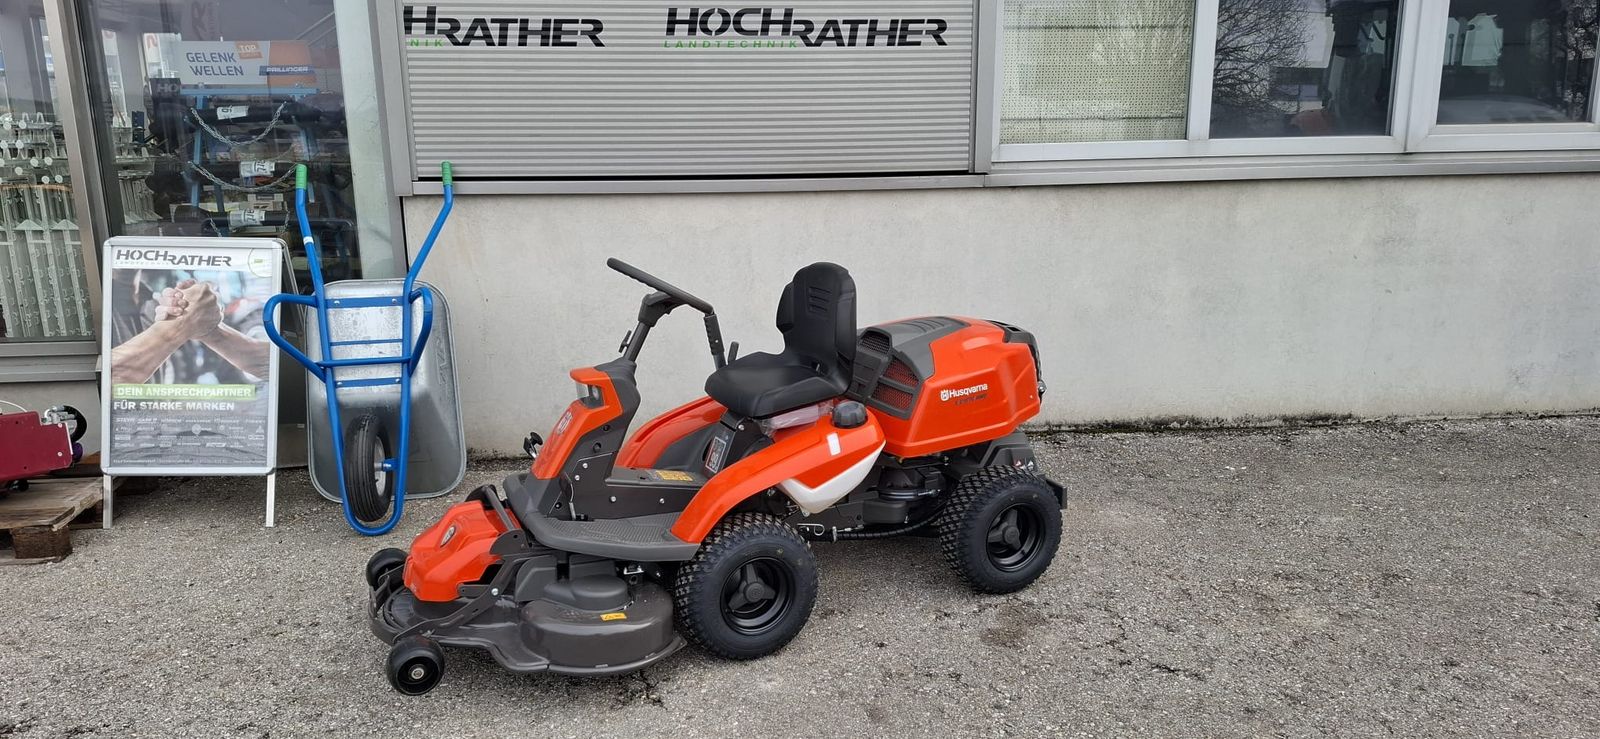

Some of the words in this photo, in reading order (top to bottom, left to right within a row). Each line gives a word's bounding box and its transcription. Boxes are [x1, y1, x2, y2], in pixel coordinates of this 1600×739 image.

[665, 7, 948, 47] HOCHRATHER
[239, 44, 257, 53] TOP
[663, 39, 797, 48] LANDTECHNIK
[186, 52, 236, 63] GELENK
[190, 65, 244, 76] WELLEN
[116, 249, 232, 267] HOCHRATHER
[117, 387, 143, 396] DEIN
[146, 387, 251, 397] ANSPRECHPARTNER
[949, 384, 988, 398] Husqvarna
[113, 400, 136, 410] FÜR
[140, 402, 183, 411] STARKE
[186, 402, 235, 411] MARKEN
